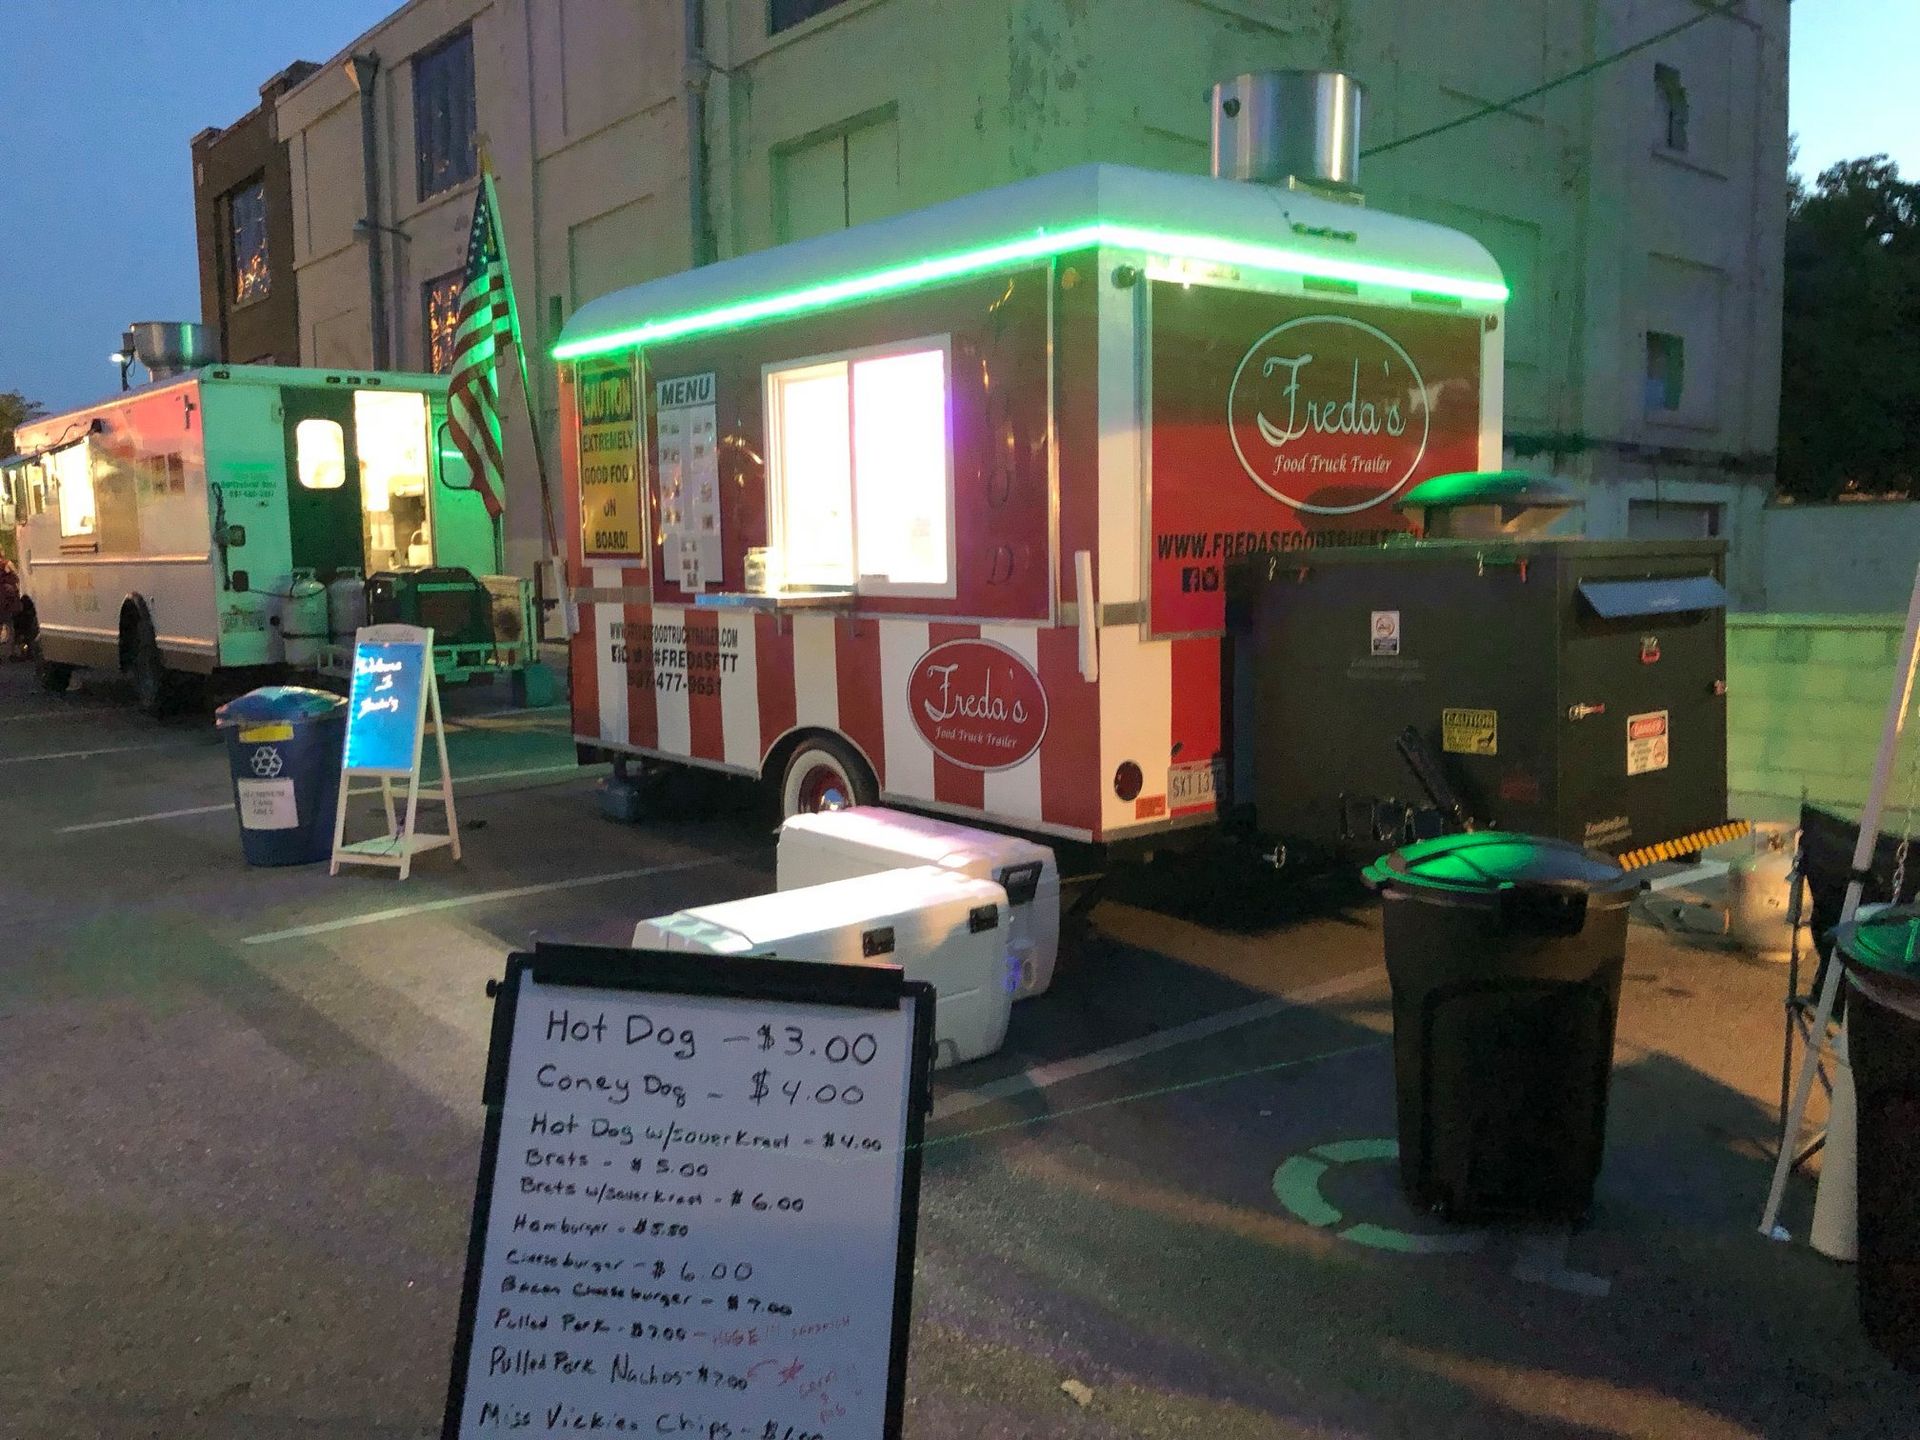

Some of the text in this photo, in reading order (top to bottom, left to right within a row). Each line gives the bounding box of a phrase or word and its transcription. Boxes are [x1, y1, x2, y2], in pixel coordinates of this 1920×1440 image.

[661, 376, 711, 406] MENU
[1257, 354, 1406, 447] Freda's
[583, 430, 633, 452] EXTREMELY
[585, 465, 608, 485] GOOD
[1272, 453, 1393, 476] Food Truck Trailer
[596, 531, 628, 550] BOARD!
[924, 663, 1029, 724] Freda's
[935, 726, 1018, 749] Food Truck Trailer
[546, 1010, 607, 1043] Hot
[626, 1014, 695, 1060] Dog
[537, 1063, 629, 1104] Coney
[644, 1074, 685, 1108] Dog
[750, 1066, 864, 1107] $4.00
[531, 1112, 579, 1135] Hot
[591, 1118, 634, 1146] Dog
[822, 1131, 882, 1152] $4.00
[525, 1148, 589, 1167] Brats
[520, 1176, 576, 1196] Brats
[513, 1212, 609, 1237] Hamburger
[501, 1274, 560, 1295] Bacon
[494, 1307, 548, 1330] Pulled
[562, 1312, 610, 1334] Pork
[489, 1344, 547, 1377] Pulled
[553, 1350, 597, 1375] Pork
[479, 1401, 530, 1429] Miss
[656, 1411, 732, 1440] Chips
